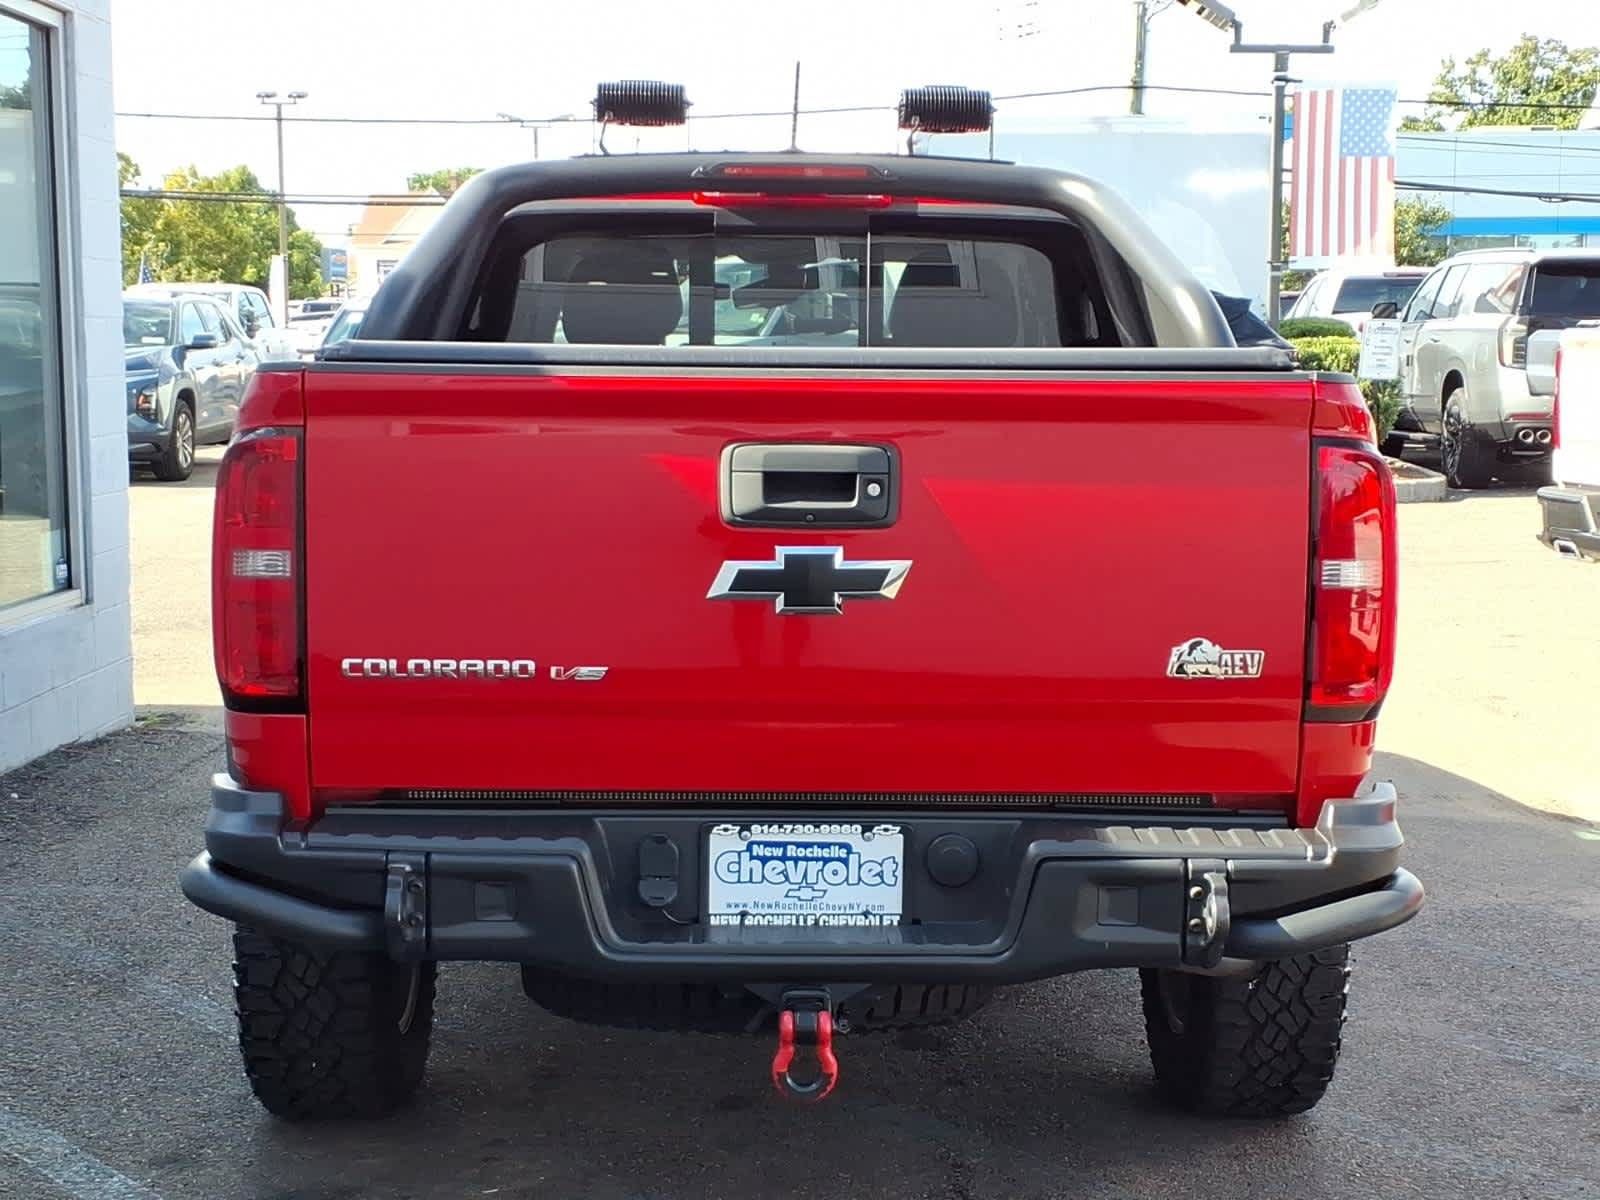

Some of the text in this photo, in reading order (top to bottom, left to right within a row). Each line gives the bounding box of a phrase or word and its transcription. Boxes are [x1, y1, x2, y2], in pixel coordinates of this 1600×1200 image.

[341, 658, 536, 678] COLORADO
[1220, 652, 1260, 675] AEV
[752, 844, 848, 858] New Rochelle
[715, 850, 899, 886] Chevrolet
